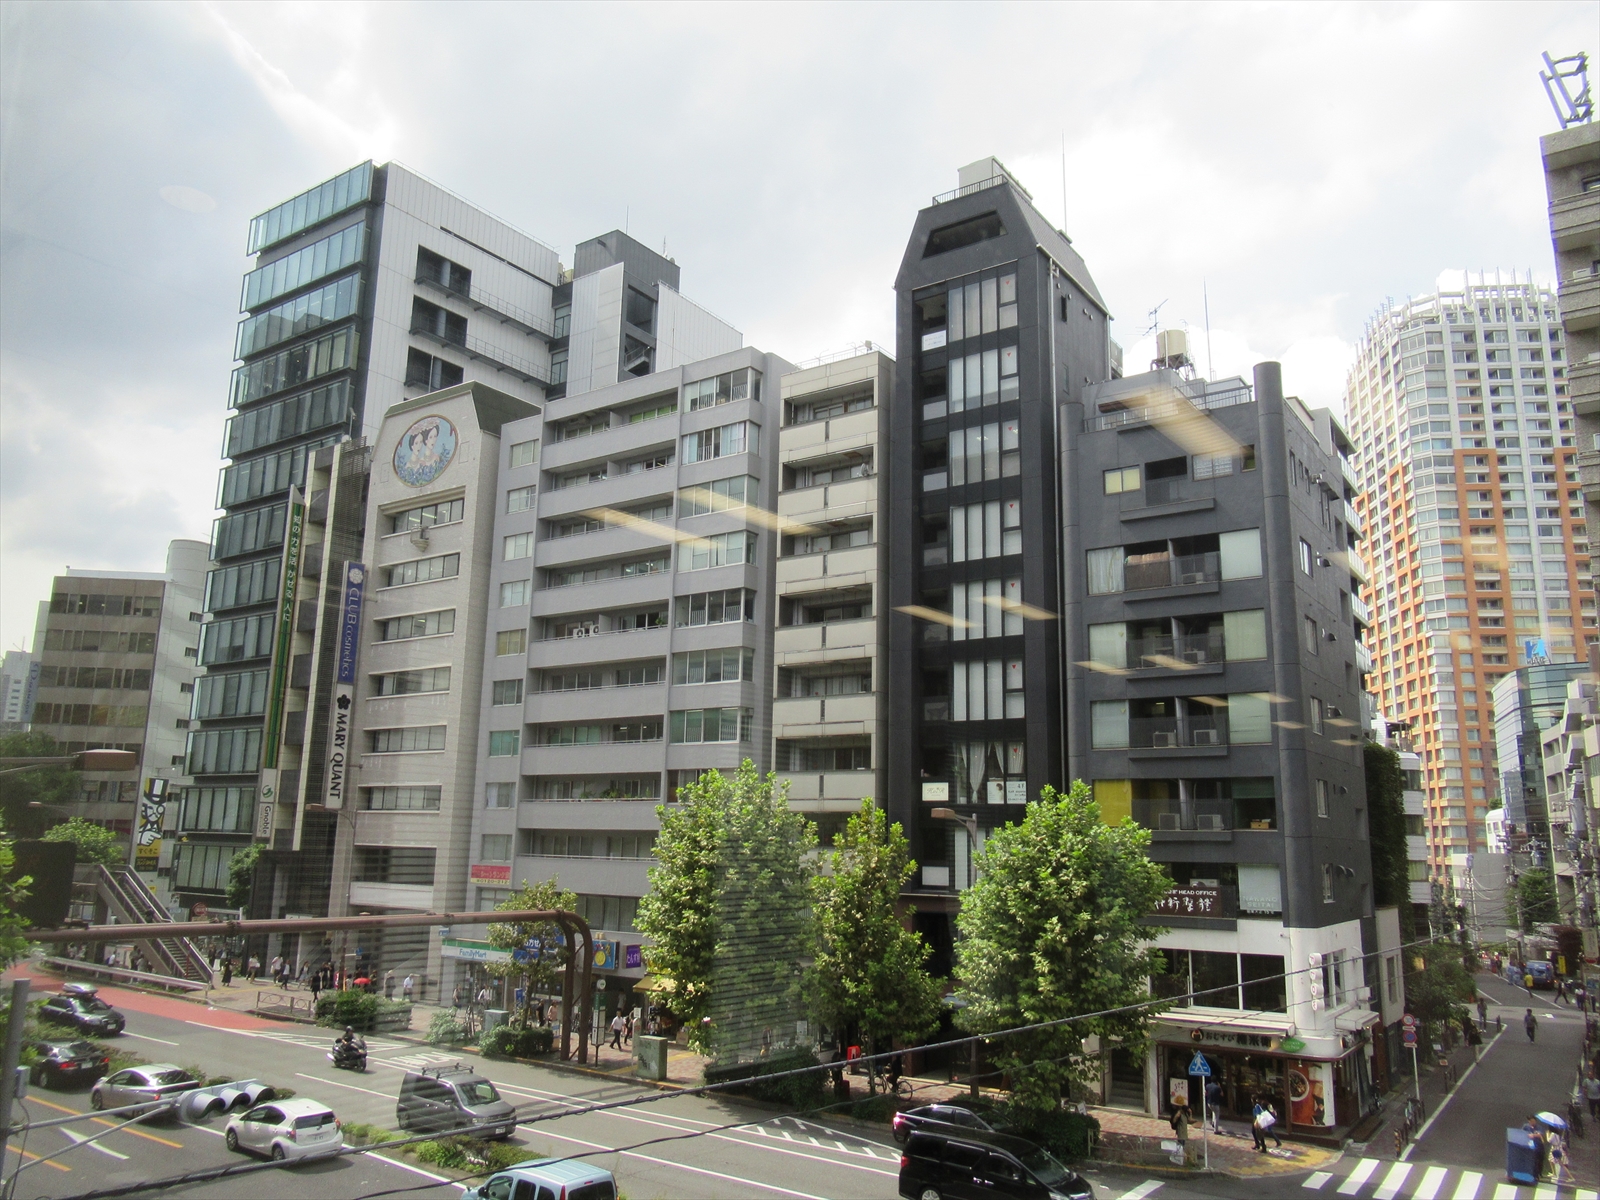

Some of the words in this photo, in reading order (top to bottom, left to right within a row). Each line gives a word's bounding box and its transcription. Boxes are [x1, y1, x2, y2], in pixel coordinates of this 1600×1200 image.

[347, 587, 360, 625] CLUB
[341, 625, 354, 677] cosmetics
[334, 712, 348, 750] MARY
[330, 752, 345, 799] QUANT
[262, 805, 272, 835] Gnoble
[459, 948, 487, 959] FamilyMart
